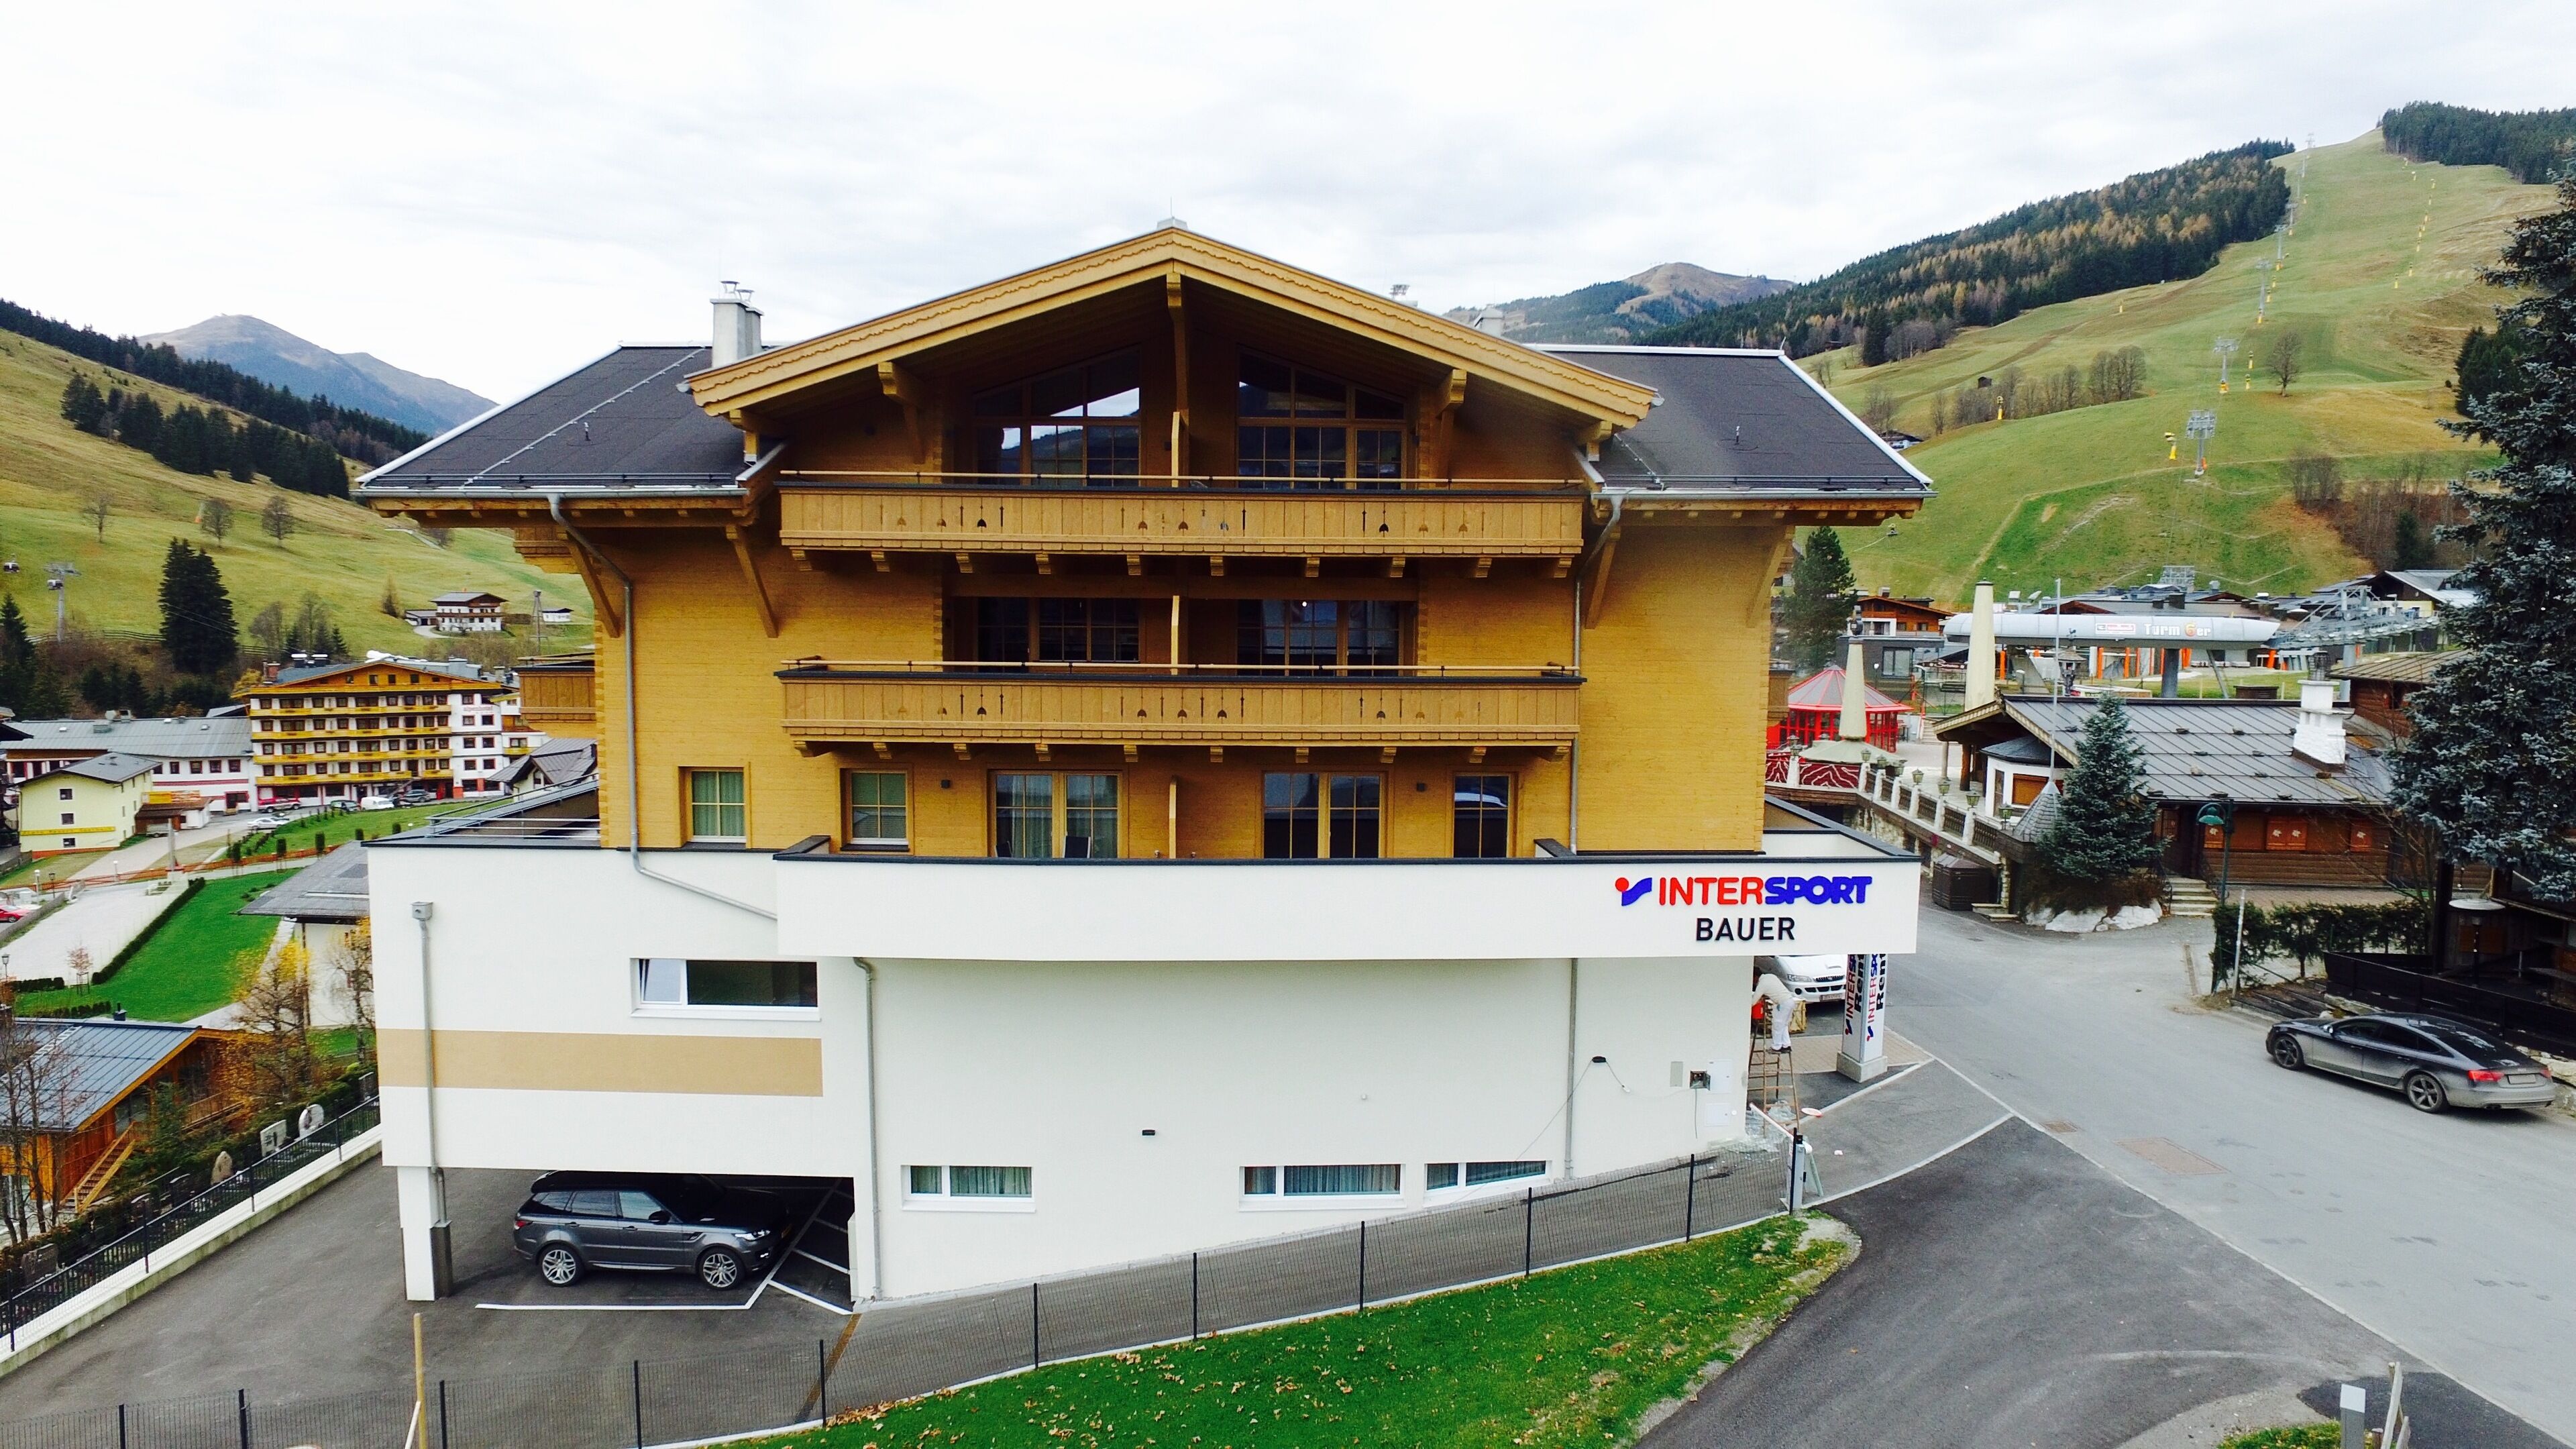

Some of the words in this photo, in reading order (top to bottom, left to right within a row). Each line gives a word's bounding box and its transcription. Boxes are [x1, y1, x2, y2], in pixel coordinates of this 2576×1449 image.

[2144, 623, 2180, 636] Turm
[1659, 875, 1872, 905] INTERSPORT
[1696, 917, 1795, 941] BAUER
